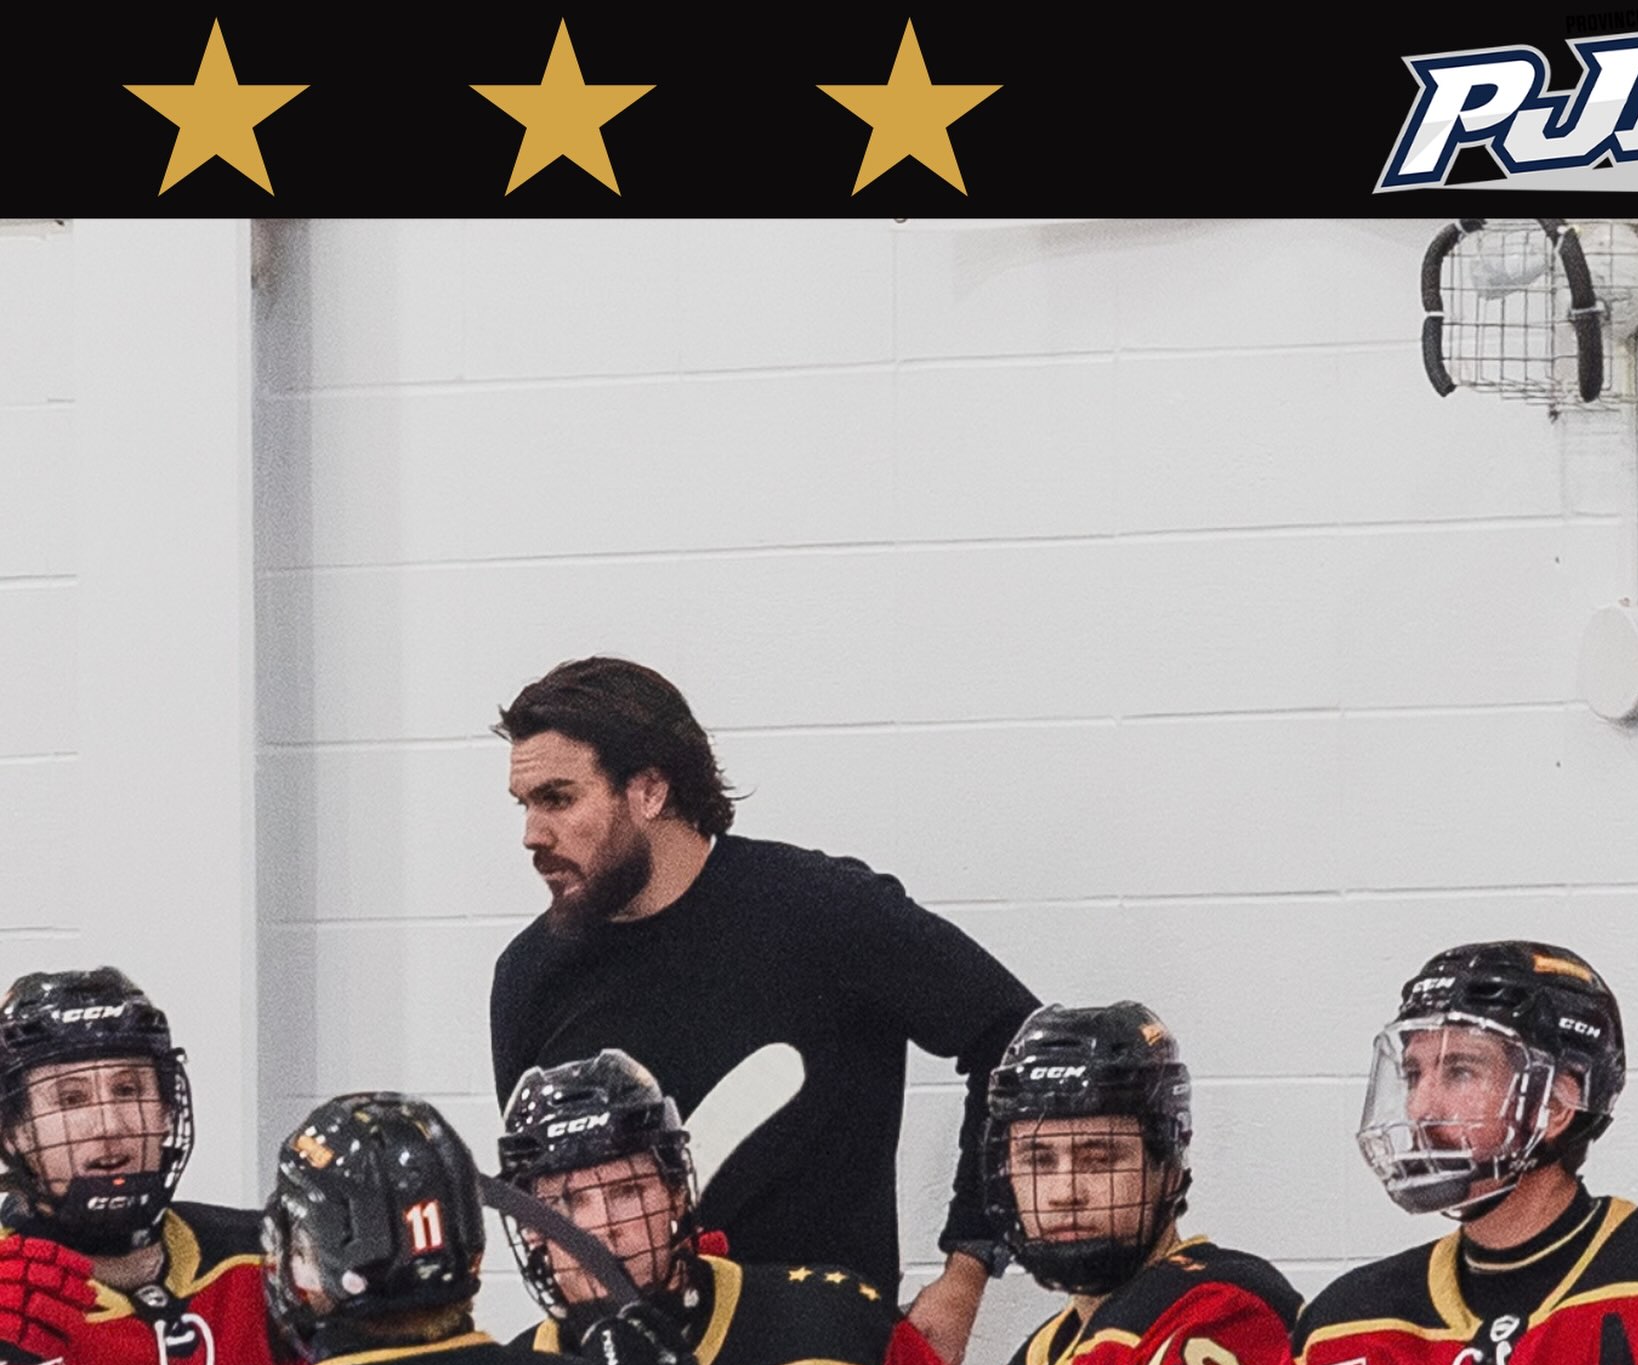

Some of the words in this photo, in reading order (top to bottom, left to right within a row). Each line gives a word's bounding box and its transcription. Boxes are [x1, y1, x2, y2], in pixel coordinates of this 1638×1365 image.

[62, 1004, 125, 1024] CCM
[1557, 1016, 1602, 1039] CCM
[1029, 1065, 1087, 1081] CCM
[546, 1111, 611, 1138] CCM
[404, 1200, 444, 1255] 11
